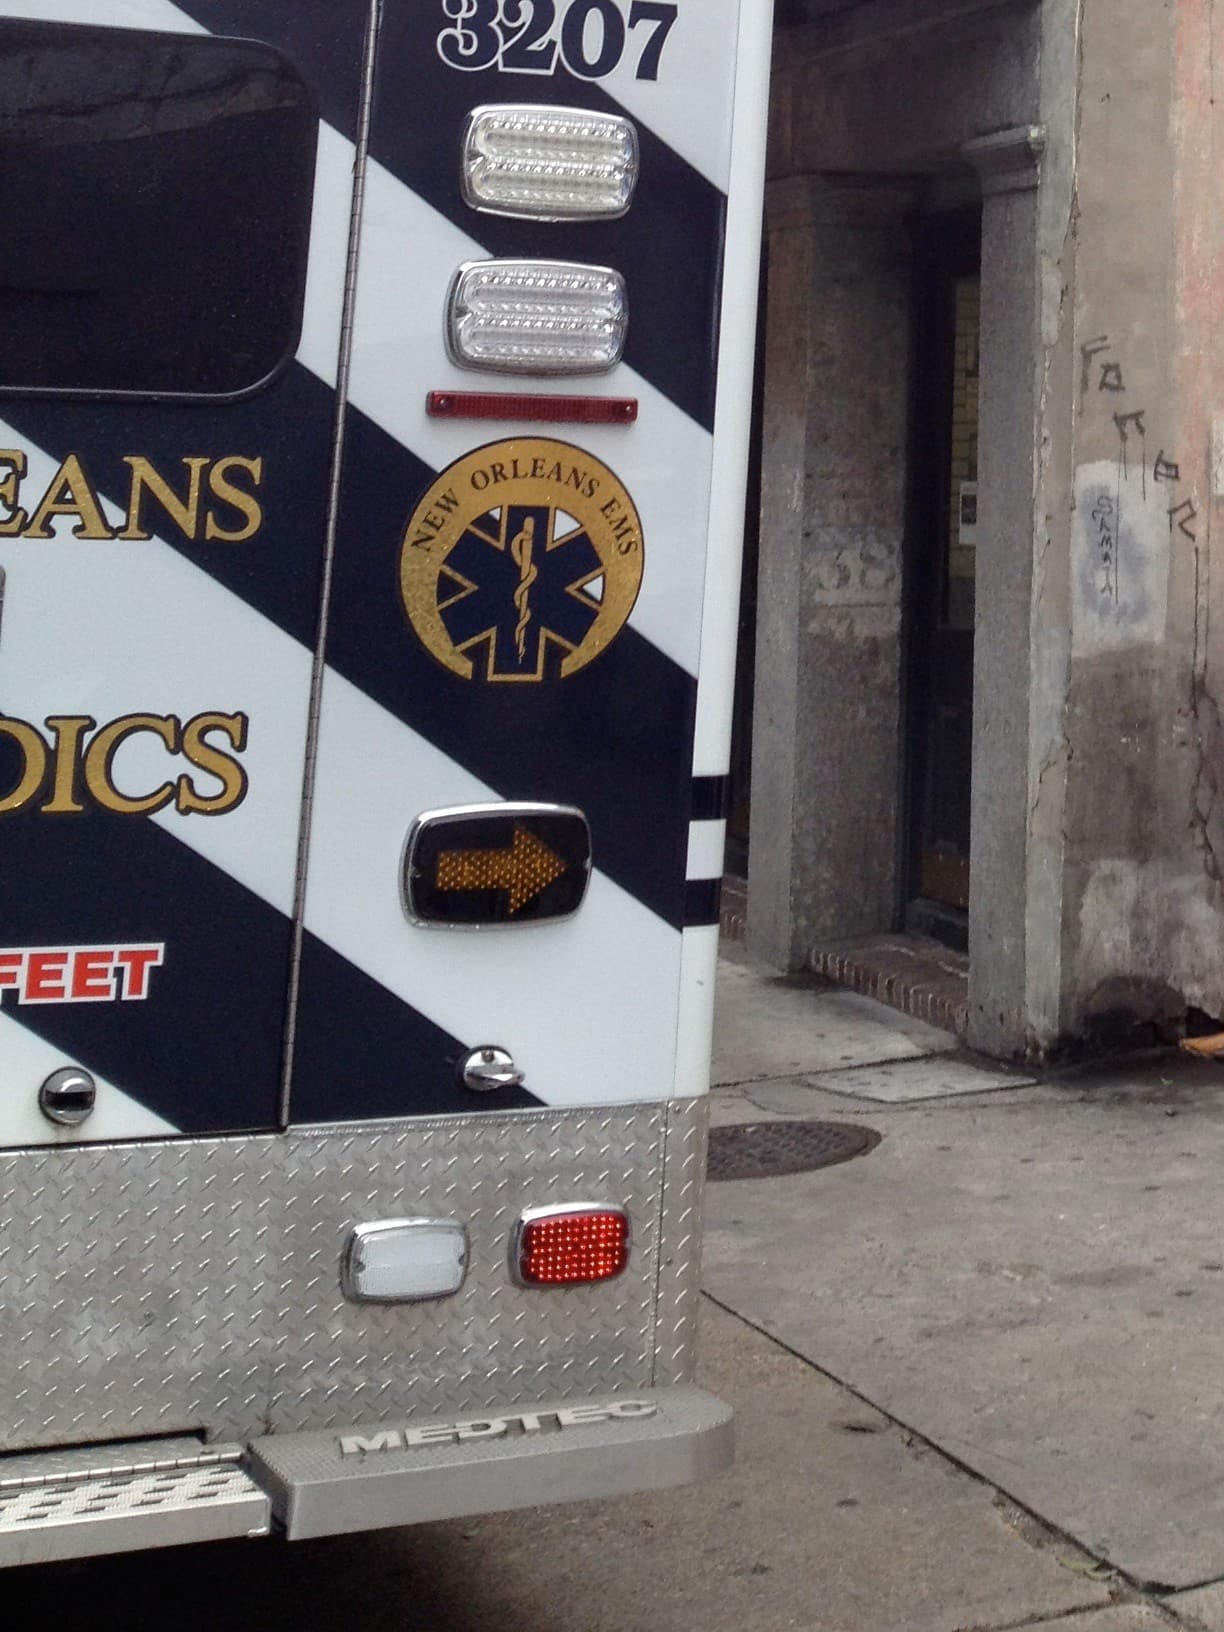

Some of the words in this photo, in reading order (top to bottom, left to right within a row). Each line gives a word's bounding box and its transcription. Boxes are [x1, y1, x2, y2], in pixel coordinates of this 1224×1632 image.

[411, 487, 460, 552] NEW
[469, 457, 600, 499] ORLEANS
[600, 496, 639, 557] EMS
[340, 1399, 658, 1457] MEDTEC
